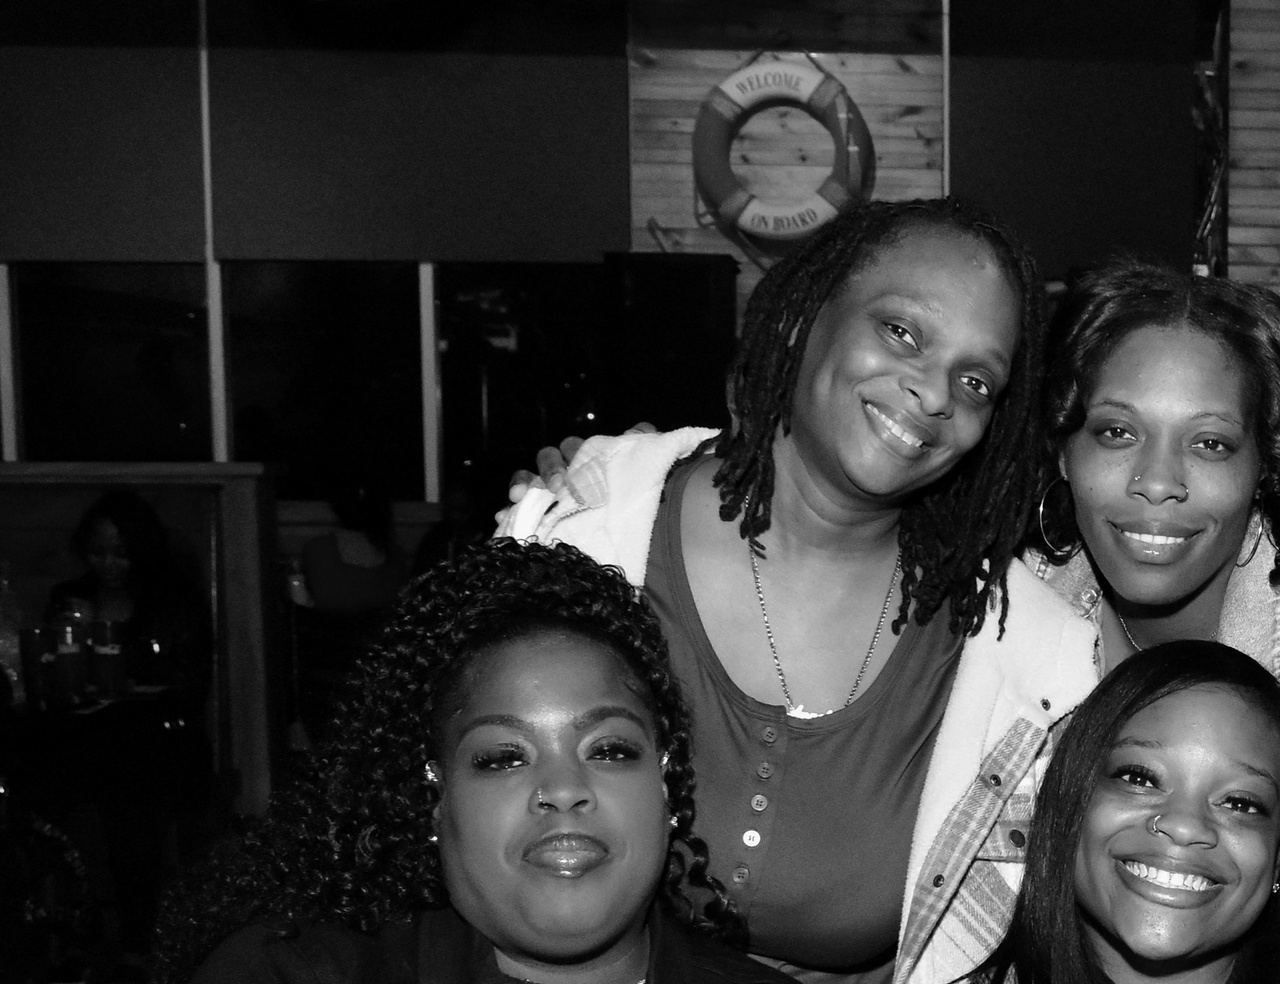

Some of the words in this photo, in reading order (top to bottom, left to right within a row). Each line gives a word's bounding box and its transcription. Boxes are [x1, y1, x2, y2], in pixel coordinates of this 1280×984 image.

[736, 71, 802, 95] WELCOME
[751, 212, 768, 229] ON
[772, 207, 818, 231] BOARD
